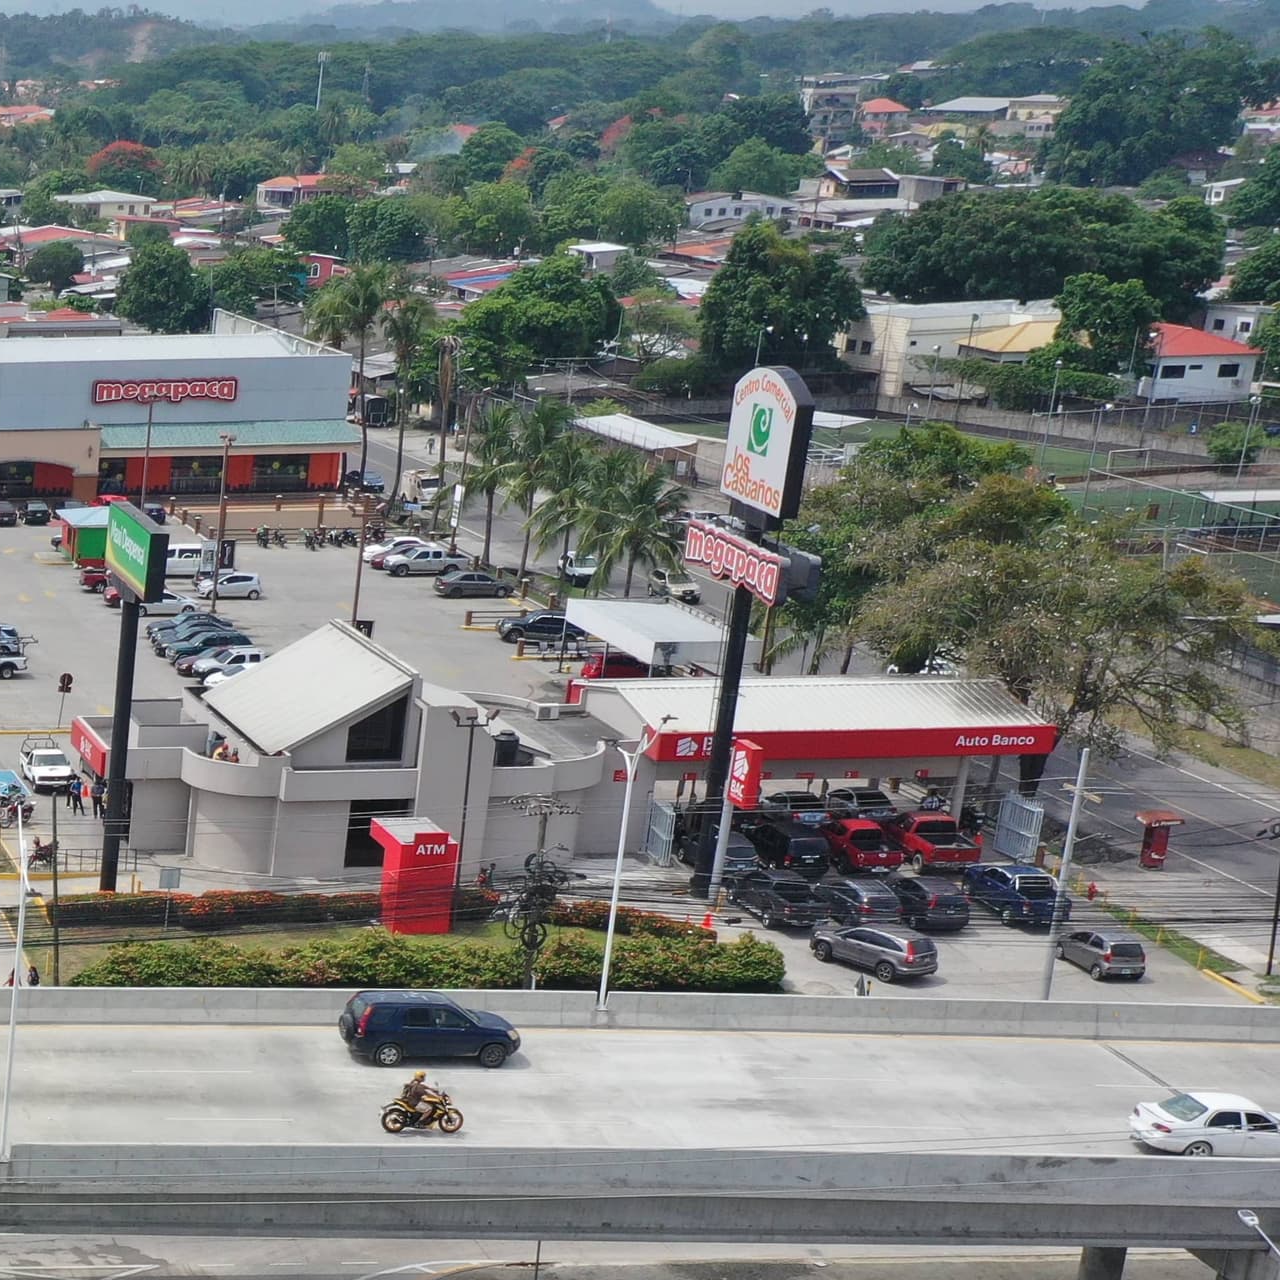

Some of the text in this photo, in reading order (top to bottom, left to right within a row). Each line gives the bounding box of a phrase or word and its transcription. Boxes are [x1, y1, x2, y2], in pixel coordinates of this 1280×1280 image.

[96, 381, 236, 402] megapaca
[735, 374, 794, 423] Centro Comercial
[731, 446, 751, 474] los
[723, 462, 780, 511] Castaños
[111, 519, 144, 566] Maxi Despensa
[686, 526, 778, 600] megapaca
[955, 734, 1035, 747] Auto Banco
[730, 779, 745, 797] BAC
[415, 844, 446, 855] ATM
